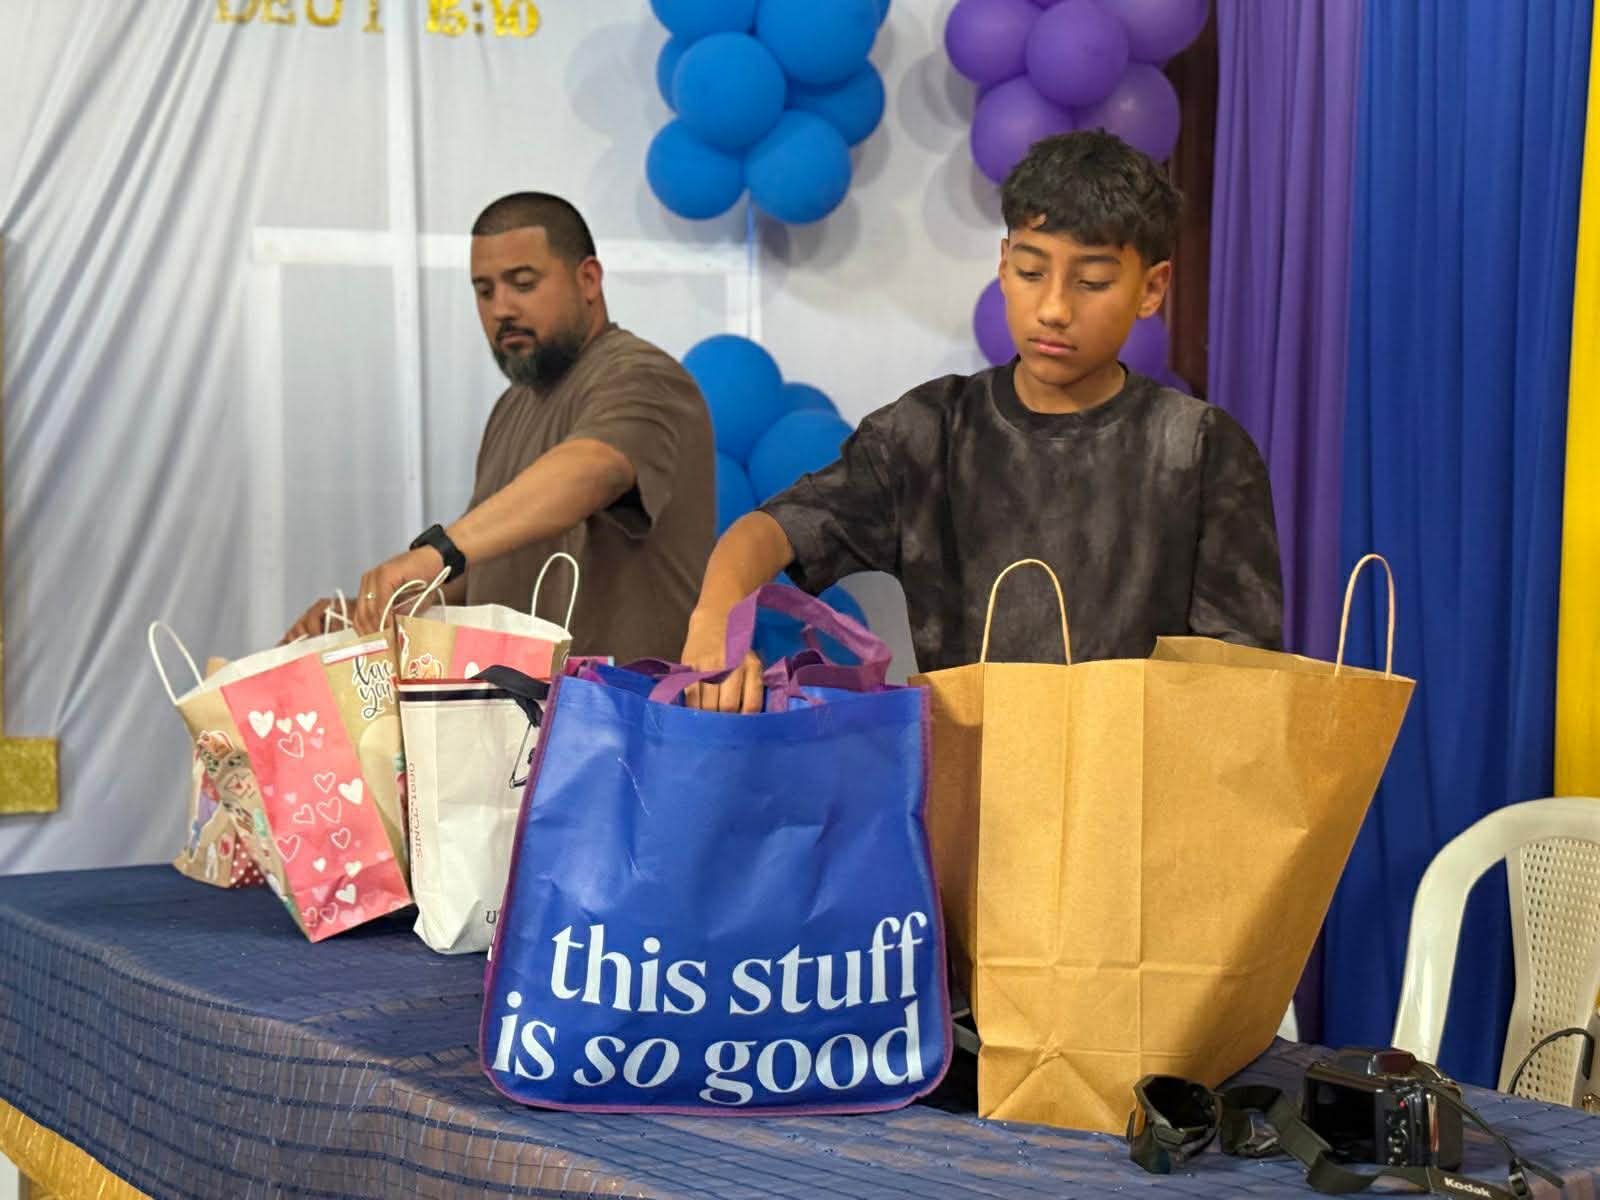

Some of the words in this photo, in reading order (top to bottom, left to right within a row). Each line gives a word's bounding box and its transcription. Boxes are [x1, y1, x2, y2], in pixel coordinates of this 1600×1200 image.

[550, 924, 706, 1014] this
[730, 911, 927, 1014] stuff
[491, 991, 556, 1080] is
[573, 1035, 680, 1088] so
[699, 1001, 925, 1105] good
[1443, 1176, 1491, 1198] Kodak
